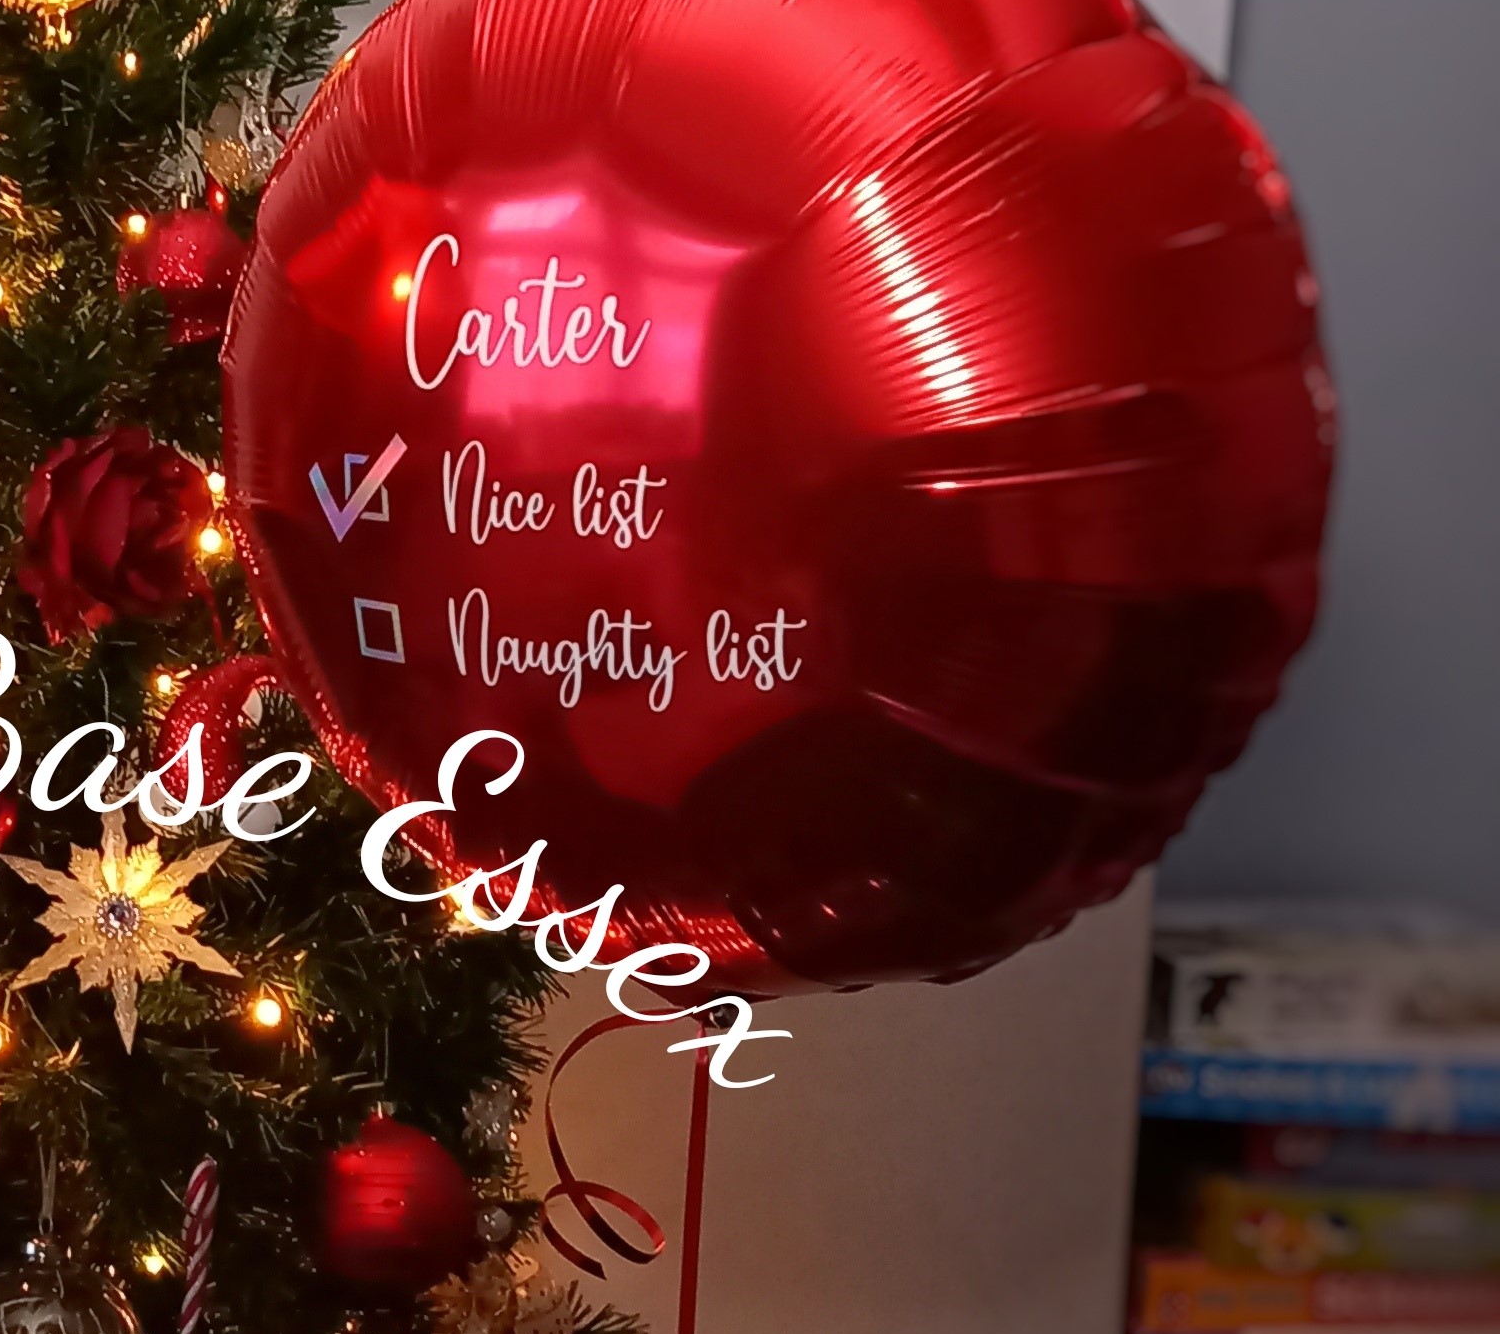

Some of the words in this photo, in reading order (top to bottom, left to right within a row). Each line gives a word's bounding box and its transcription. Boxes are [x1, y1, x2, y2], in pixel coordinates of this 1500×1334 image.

[405, 233, 652, 391] Carter
[442, 439, 556, 545] Nice
[572, 462, 668, 549] list
[447, 587, 688, 713] Naughty
[705, 607, 808, 691] list
